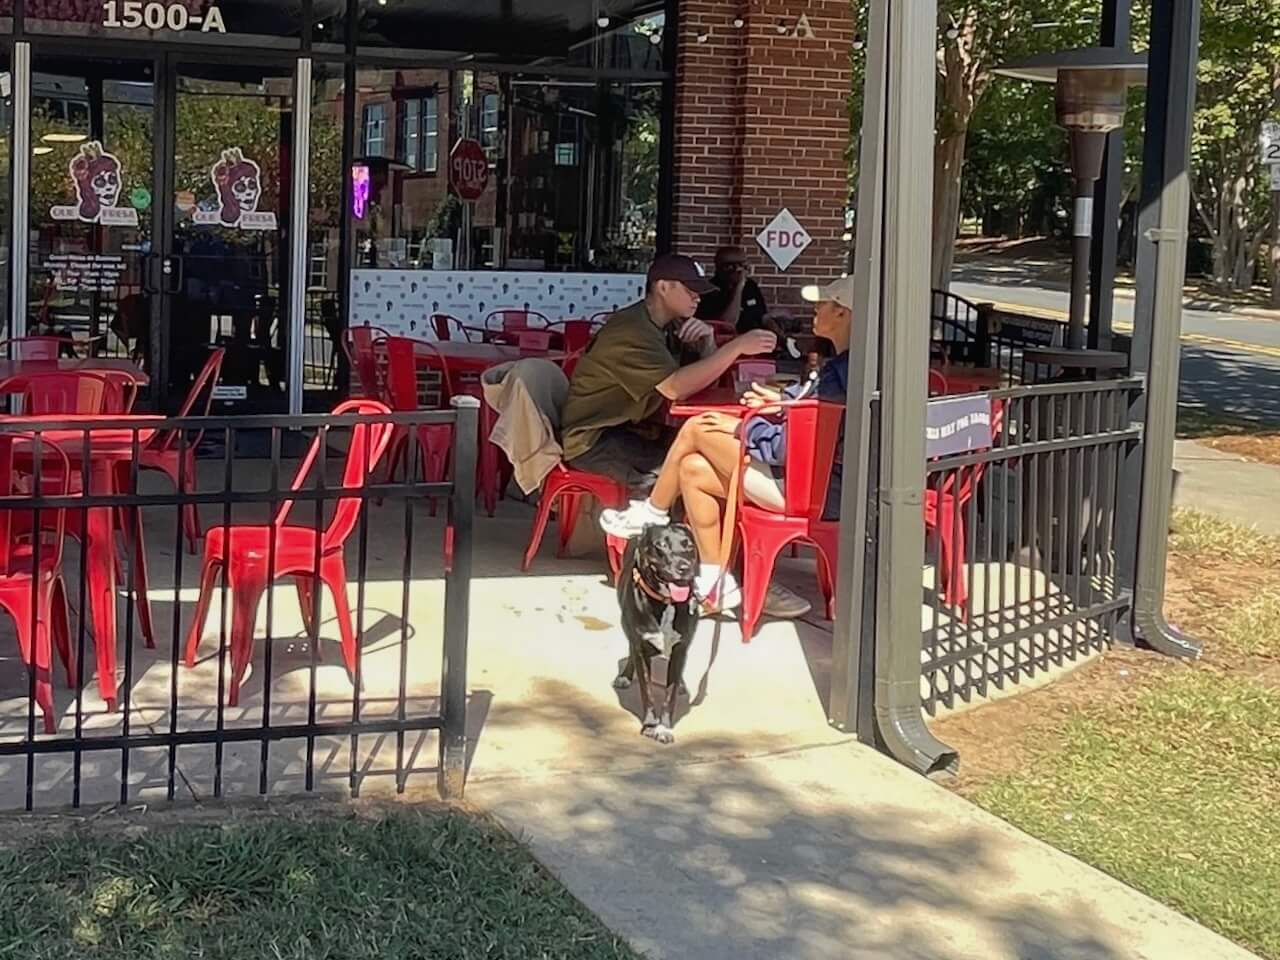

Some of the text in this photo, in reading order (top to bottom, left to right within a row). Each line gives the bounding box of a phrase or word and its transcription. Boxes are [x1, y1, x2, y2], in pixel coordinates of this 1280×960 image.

[102, 0, 226, 33] 1500-A
[790, 10, 816, 39] A
[766, 230, 805, 249] FDC
